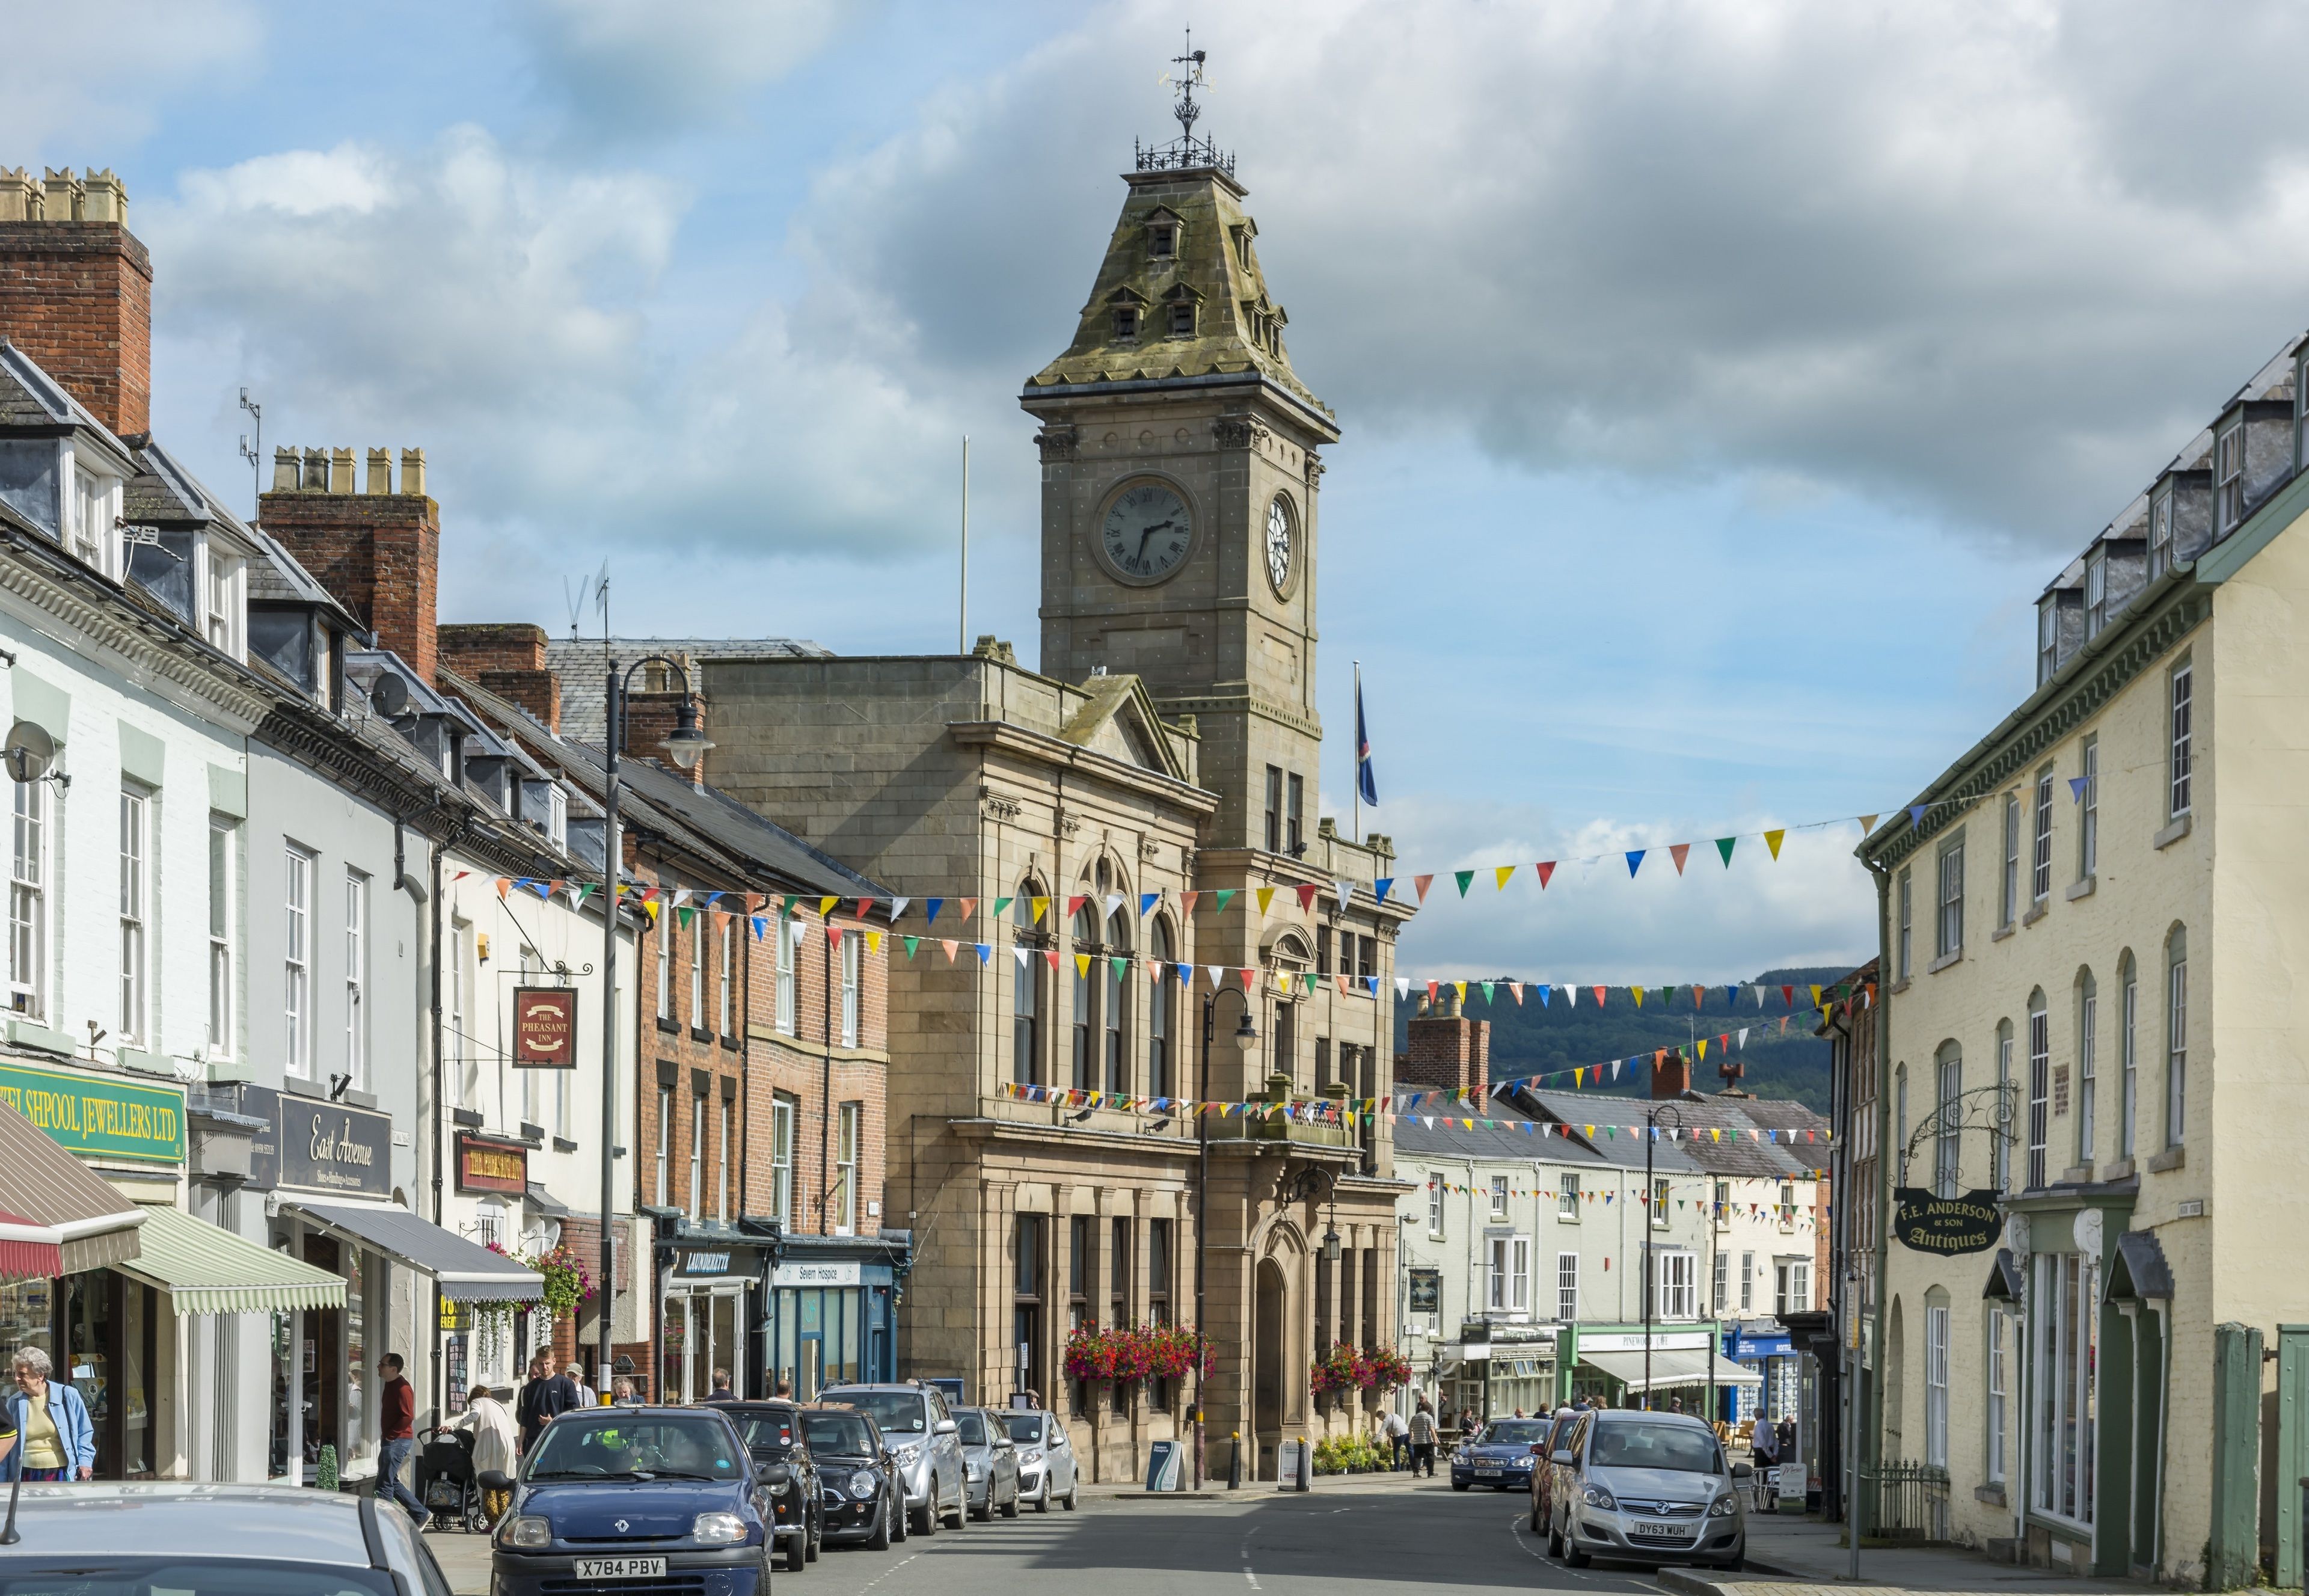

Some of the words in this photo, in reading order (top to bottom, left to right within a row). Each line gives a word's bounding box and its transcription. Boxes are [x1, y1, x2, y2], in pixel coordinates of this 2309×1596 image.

[522, 1022, 568, 1033] PHEASANT
[82, 1097, 150, 1140] JEWELLERS
[153, 1106, 176, 1141] LTD
[310, 1114, 334, 1161] East
[336, 1117, 372, 1166] Avenue
[175, 1143, 180, 1156] 41
[468, 1149, 483, 1176] THE
[317, 1170, 327, 1183] Shoes
[1900, 1205, 1923, 1221] F.E.
[1927, 1202, 1996, 1223] ANDERSON
[1908, 1227, 1987, 1251] Antiques
[686, 1251, 731, 1273] LAUNDERETTE
[799, 1266, 816, 1280] Severn
[818, 1266, 837, 1283] Hospice
[1623, 1336, 1652, 1347] PINEWOD
[1639, 1524, 1664, 1534] DY63
[1667, 1526, 1685, 1535] WUH
[583, 1561, 624, 1576] X784
[629, 1560, 660, 1575] PBV
